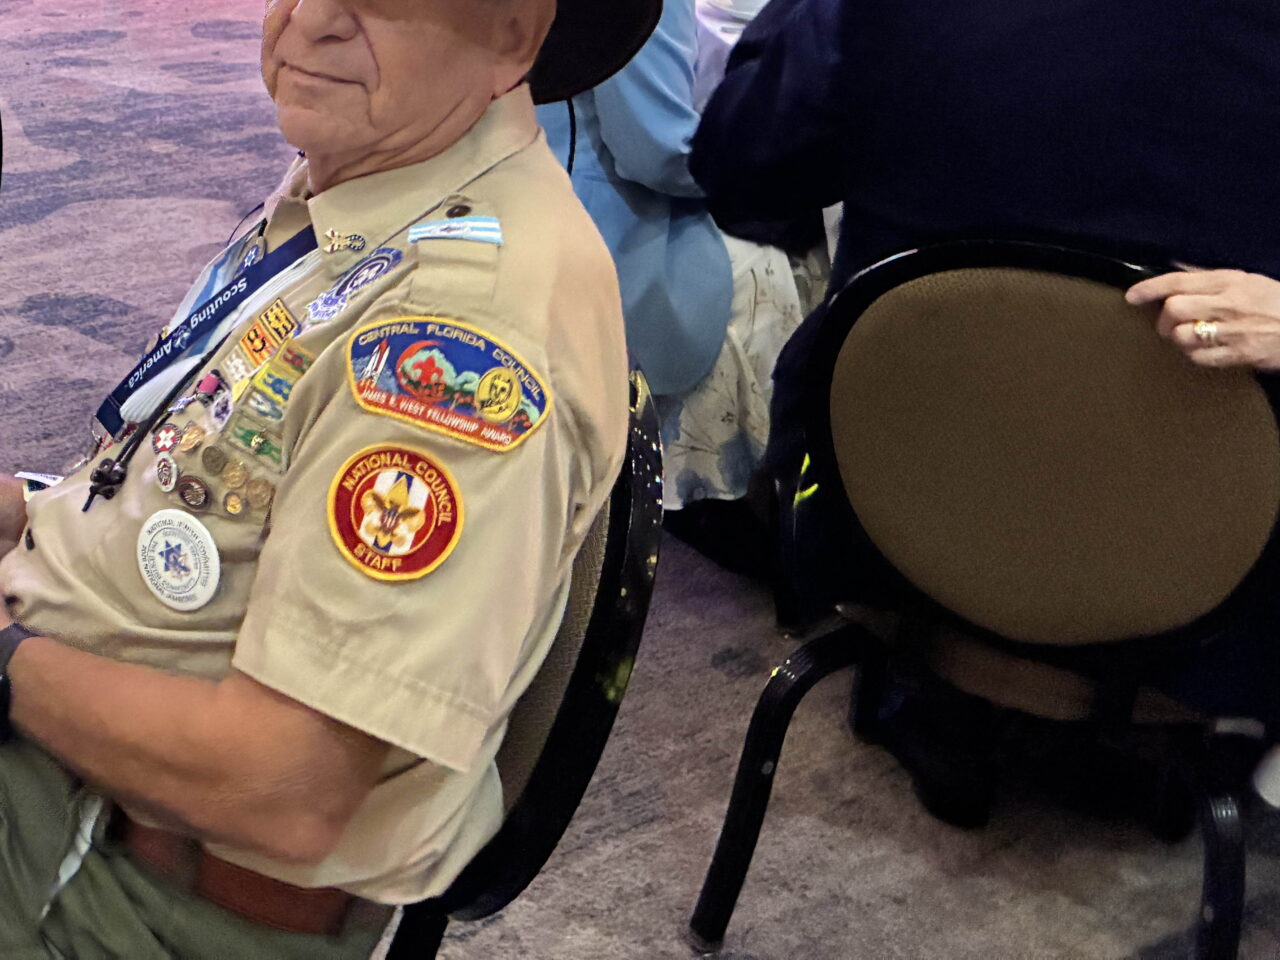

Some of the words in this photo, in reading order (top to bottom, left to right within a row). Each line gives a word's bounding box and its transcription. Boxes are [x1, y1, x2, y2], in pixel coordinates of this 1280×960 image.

[190, 277, 248, 330] Scouting
[128, 340, 173, 389] America
[359, 323, 420, 346] CENTRAL
[426, 324, 486, 352] FLORIDA
[492, 348, 541, 401] COUNCIL
[426, 406, 479, 433] FELLOWSHIP
[342, 452, 412, 491] NATIONAL
[415, 461, 453, 527] COUNCIL
[353, 543, 402, 572] STAFF
